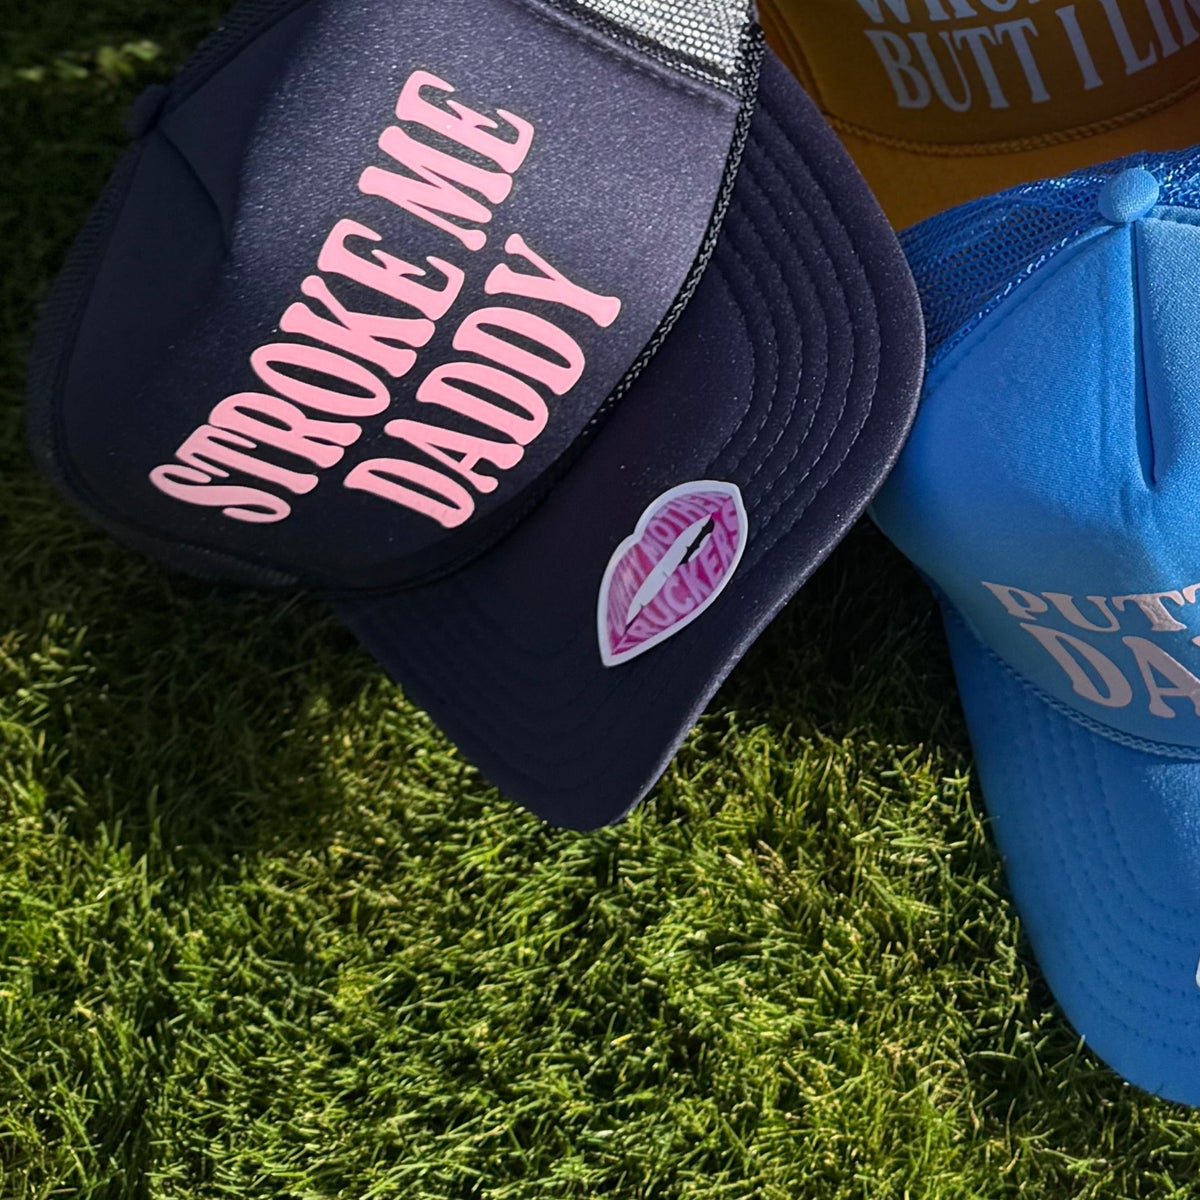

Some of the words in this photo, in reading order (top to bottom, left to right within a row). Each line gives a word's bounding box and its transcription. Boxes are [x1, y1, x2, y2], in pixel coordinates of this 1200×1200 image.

[864, 17, 1051, 113] BUTT
[1055, 3, 1104, 91] I
[148, 218, 465, 524] STROKE
[357, 69, 535, 251] ME
[342, 232, 622, 529] DADDY
